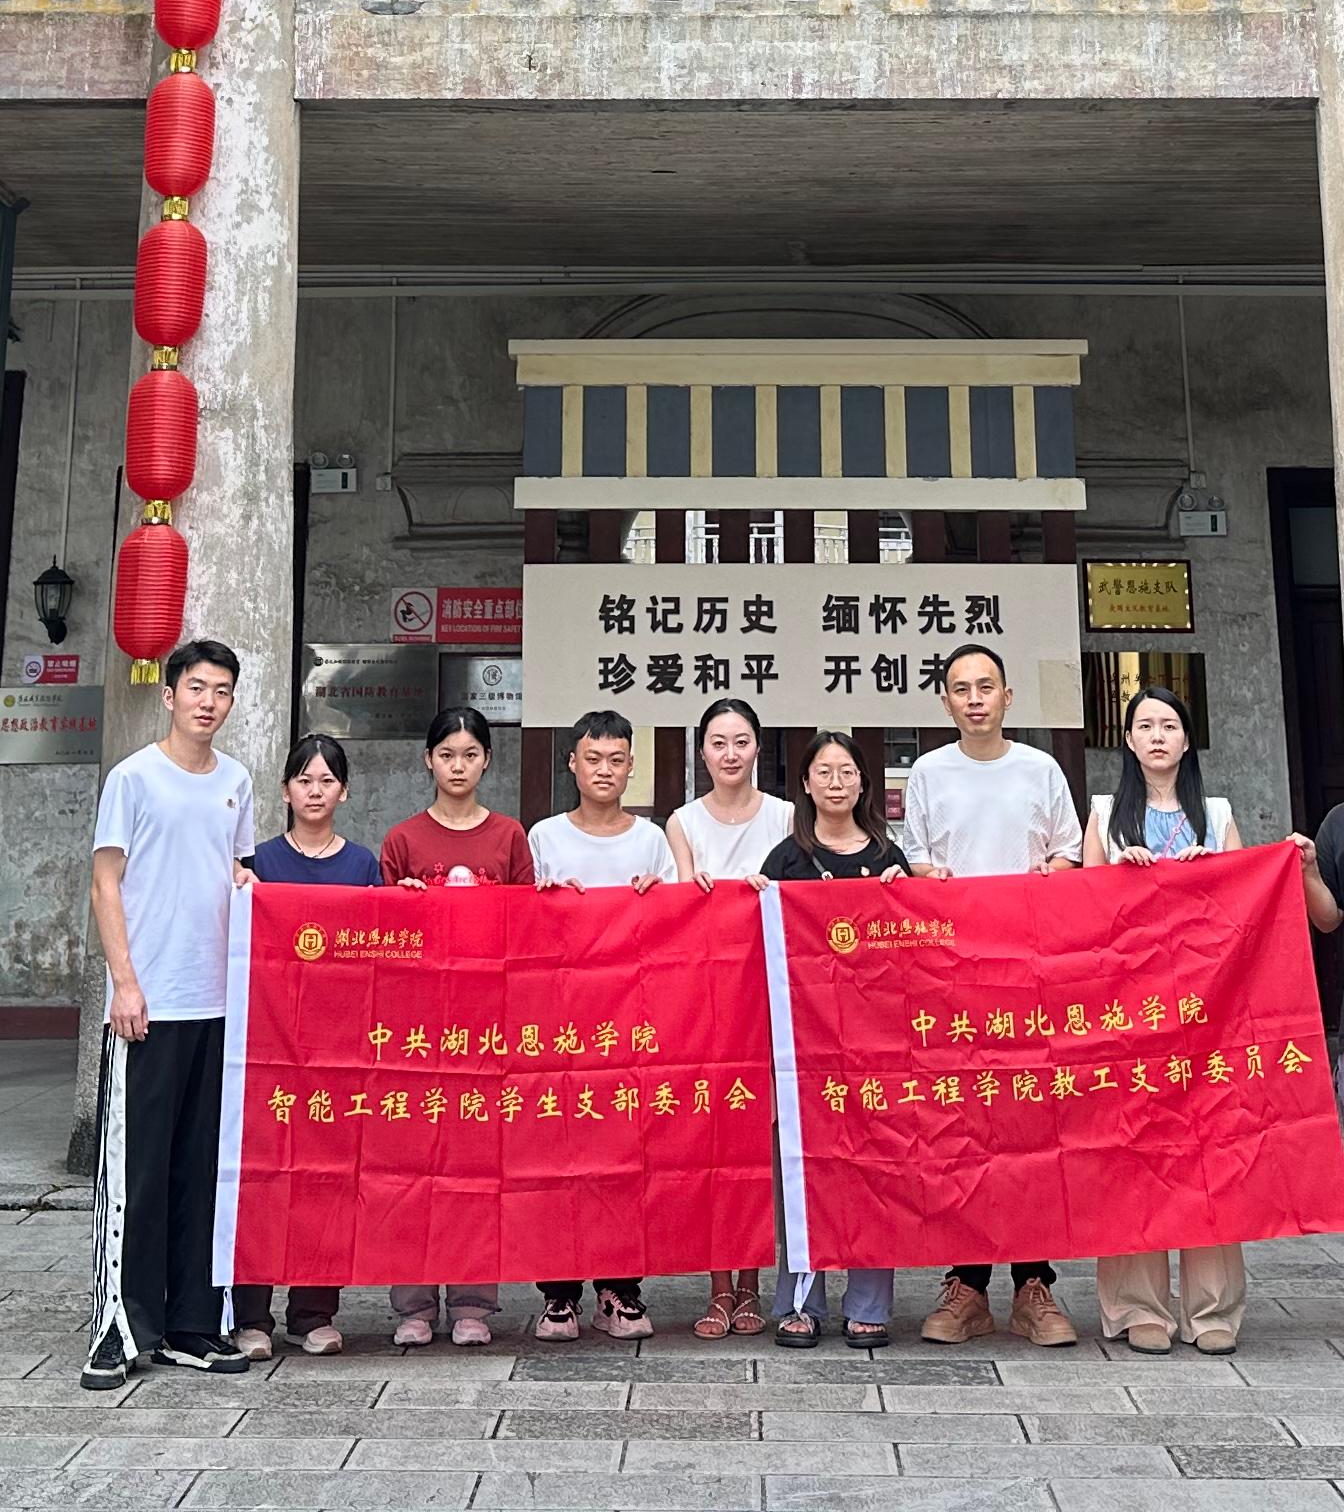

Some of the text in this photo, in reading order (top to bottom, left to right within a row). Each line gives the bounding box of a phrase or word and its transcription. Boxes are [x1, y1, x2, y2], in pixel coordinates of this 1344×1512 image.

[1098, 578, 1178, 596] 武警恩施支队
[598, 593, 1004, 636] 铭记历史 缅怀先烈
[598, 652, 779, 695] 珍爱和平
[334, 927, 424, 948] 湖北恩施学院
[867, 918, 955, 939] 湖北恩施学院
[868, 941, 893, 950] HUBEI
[334, 950, 358, 959] HUBEI
[385, 950, 423, 959] COLLEGE
[367, 1020, 659, 1061] 中共湖北恩施学院
[911, 992, 1208, 1048] 中共湖北恩施学院
[821, 1040, 1313, 1115] 智能工程学院教工支部委员会
[267, 1077, 757, 1125] 智能工程学院学生支部委员会
